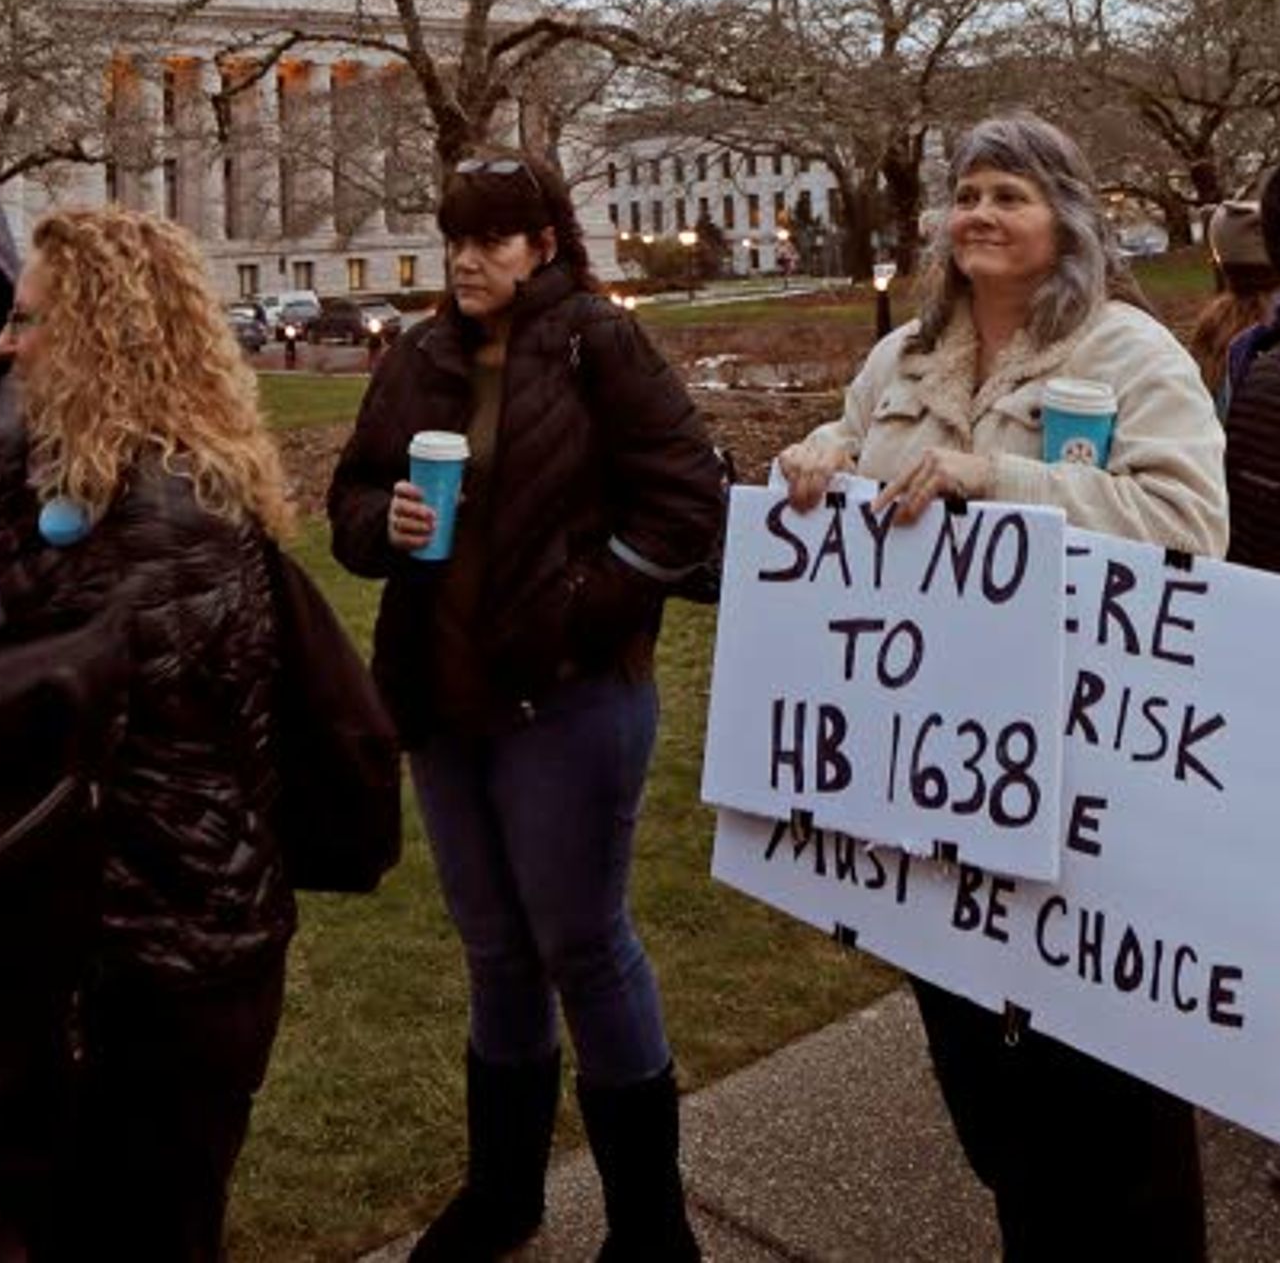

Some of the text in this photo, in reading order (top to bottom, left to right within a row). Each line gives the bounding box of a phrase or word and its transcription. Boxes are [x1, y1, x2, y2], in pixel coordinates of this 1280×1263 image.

[757, 498, 1029, 605] SAY NO
[828, 619, 925, 689] TO
[771, 699, 1041, 828] HB 1638
[1064, 669, 1227, 792] RISK
[951, 863, 1017, 944] BE
[1035, 894, 1244, 1029] CHOICE
